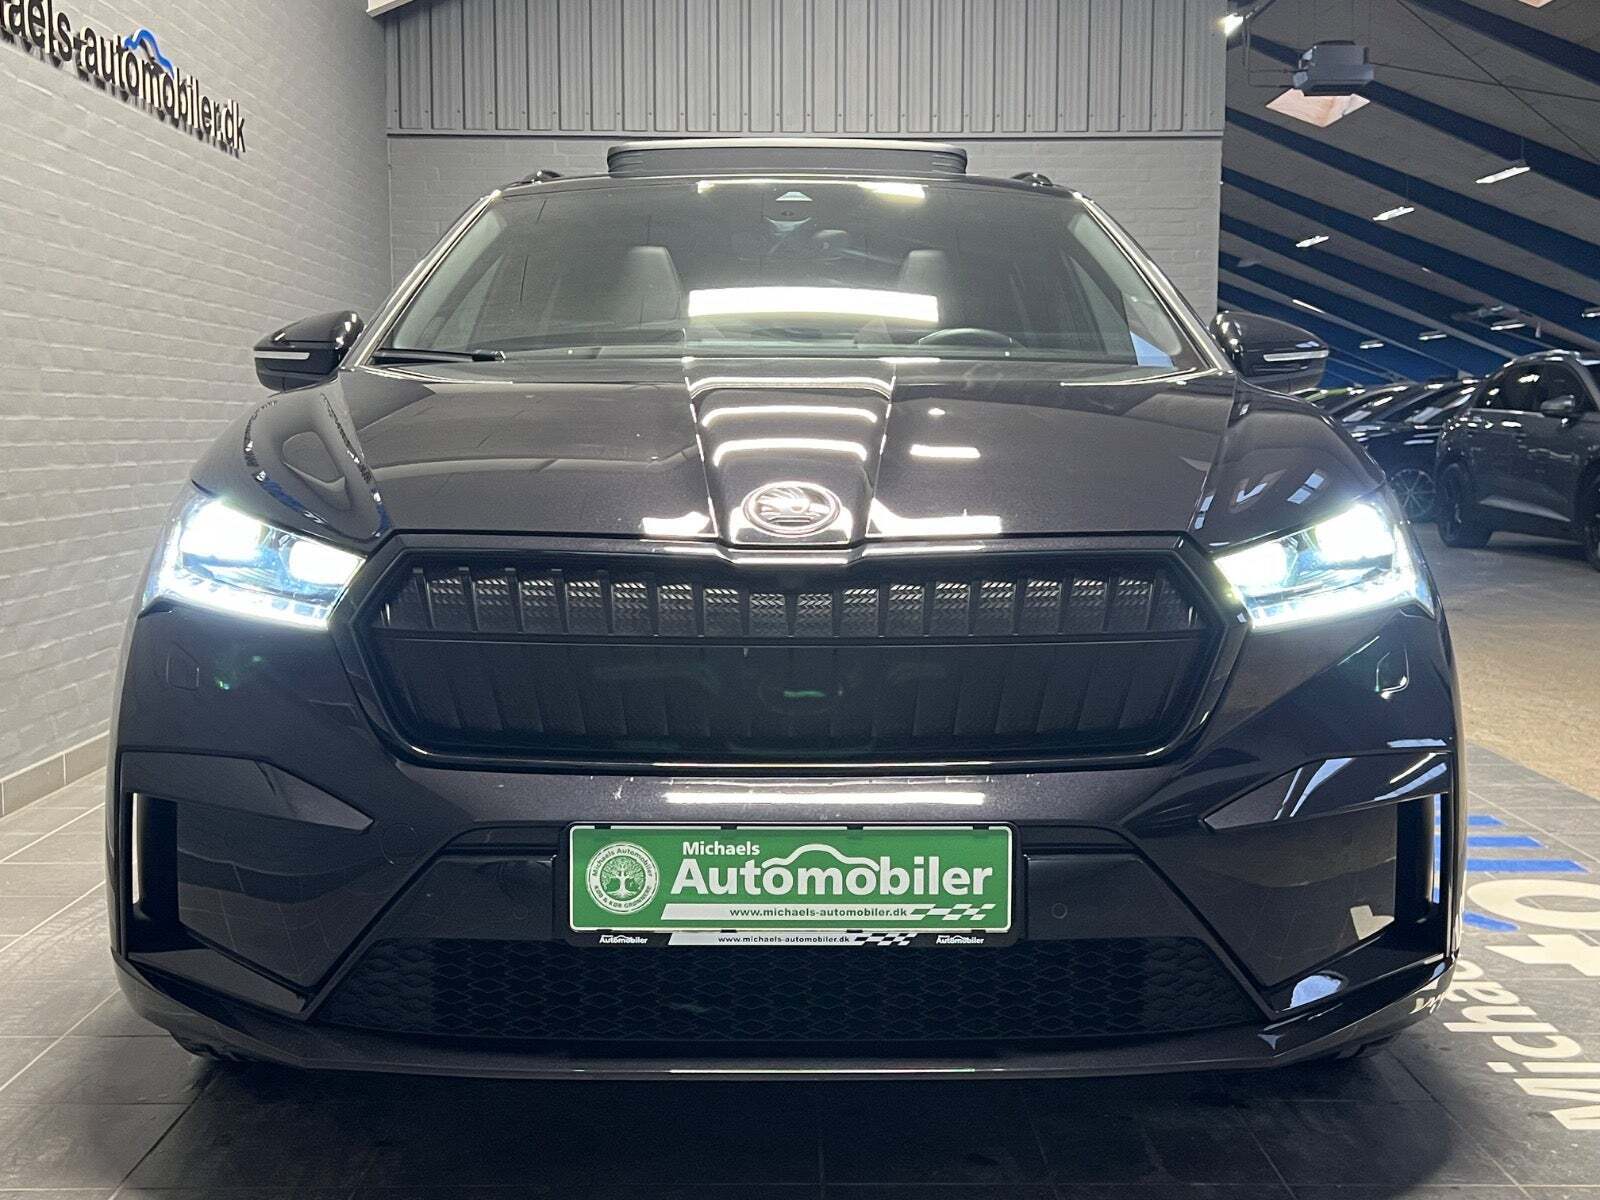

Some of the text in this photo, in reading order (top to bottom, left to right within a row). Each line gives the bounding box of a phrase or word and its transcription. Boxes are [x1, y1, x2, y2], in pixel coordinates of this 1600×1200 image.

[682, 841, 760, 856] Michaels
[592, 848, 653, 877] Michaels Automobiler
[670, 856, 993, 896] Automobiler
[729, 907, 907, 917] www.michaels-automobiler.dk
[599, 935, 648, 944] Automobiler
[718, 935, 849, 943] www.michaels-automobiler.dk
[936, 935, 985, 944] Automobiler
